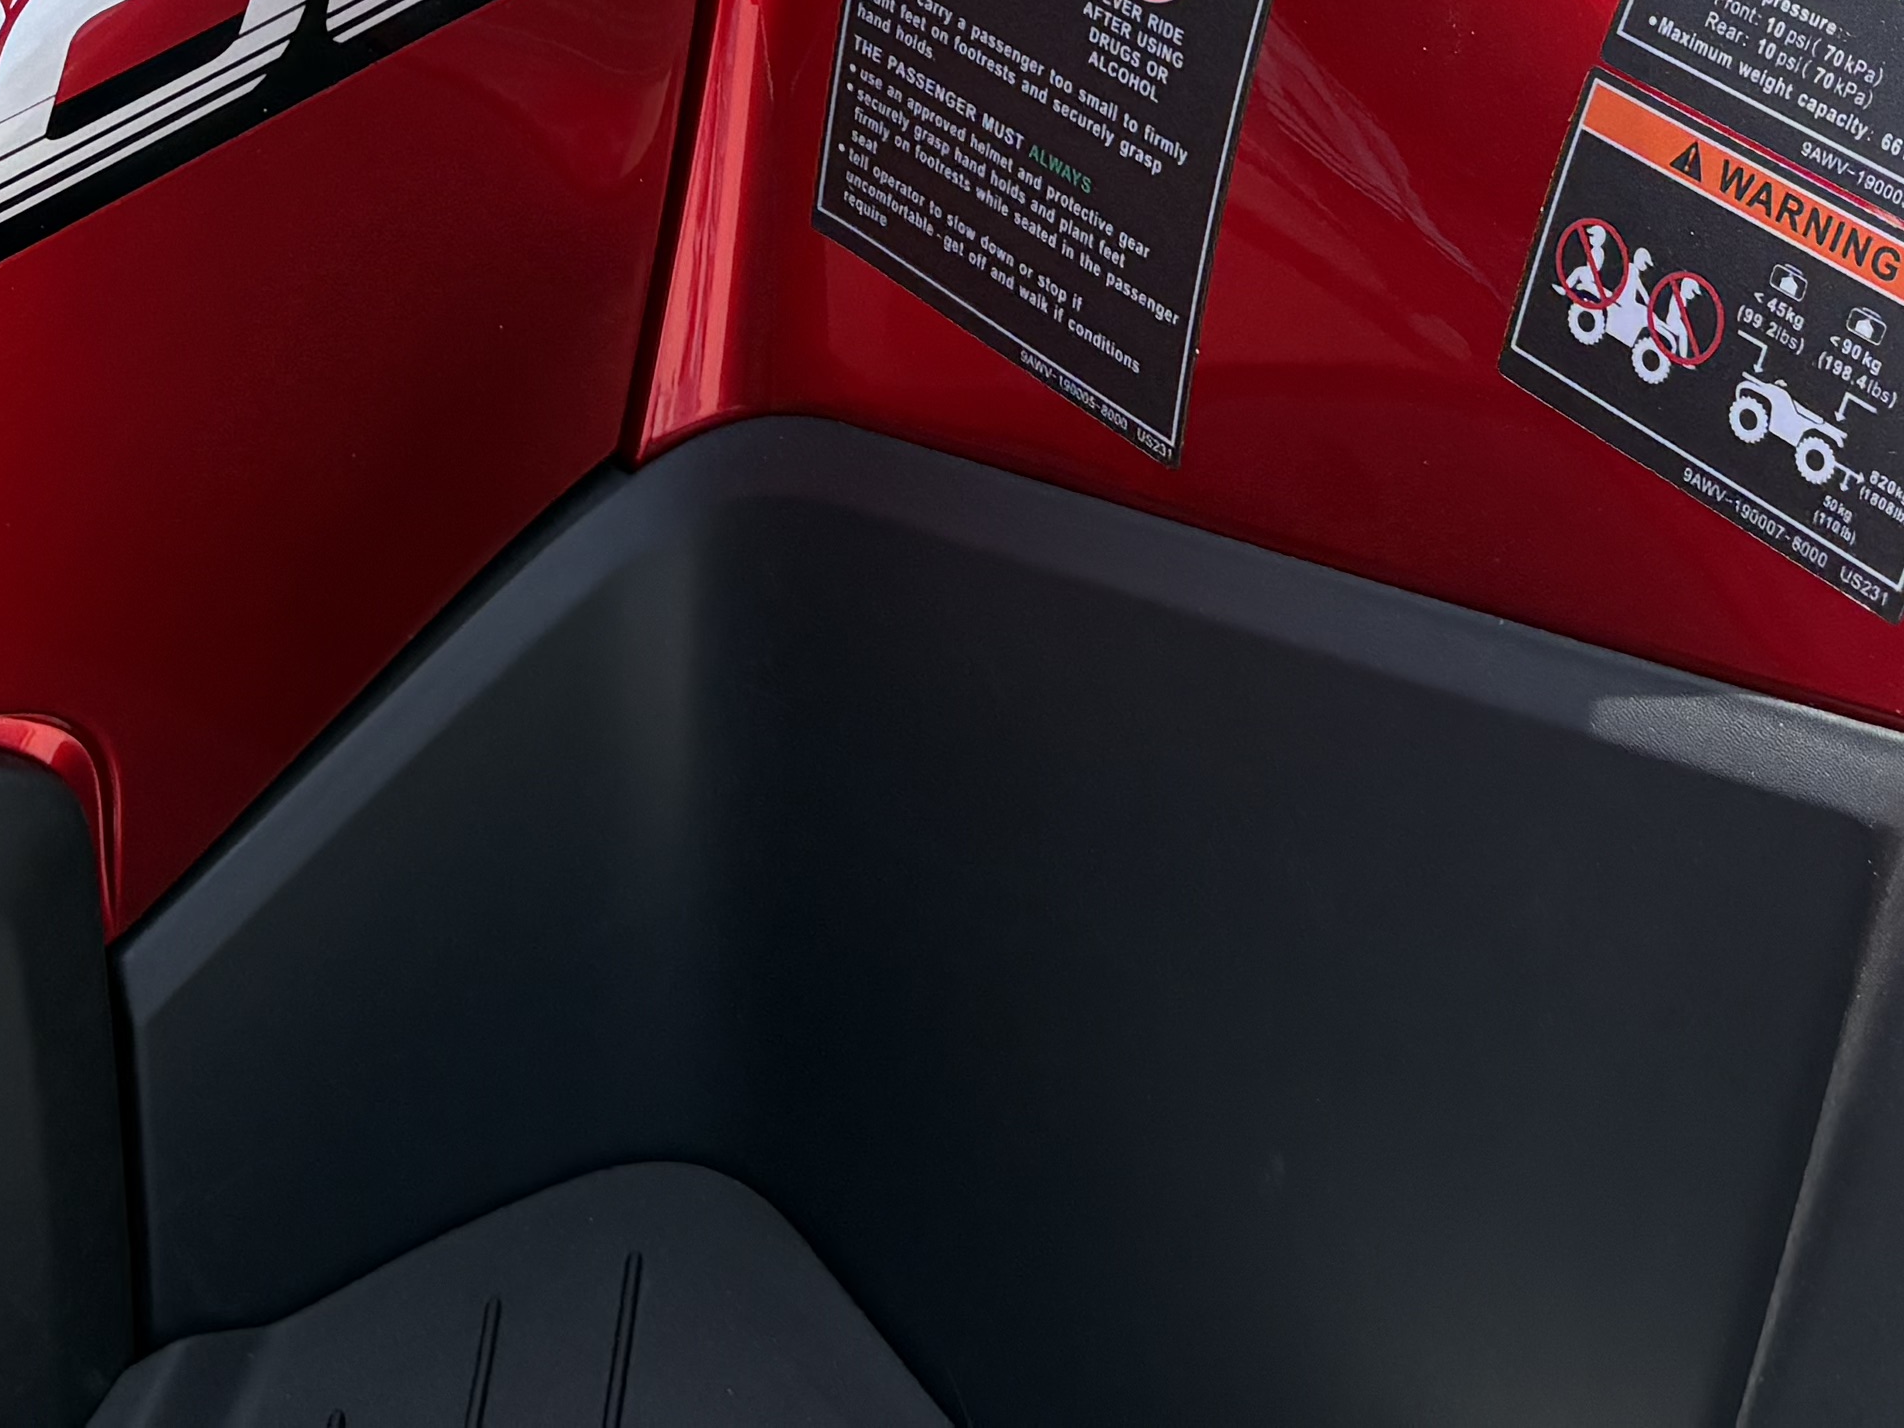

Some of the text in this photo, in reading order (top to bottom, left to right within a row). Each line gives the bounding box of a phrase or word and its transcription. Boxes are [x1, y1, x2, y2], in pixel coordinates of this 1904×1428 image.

[857, 2, 891, 33] hand
[1082, 1, 1184, 68] AFTER USING
[1088, 26, 1168, 84] DRUGS OR
[1147, 13, 1184, 46] RIDE
[1704, 11, 1749, 46] Rear:
[900, 4, 926, 31] feet
[930, 26, 949, 45] on
[953, 35, 1016, 85] footrests
[1021, 79, 1048, 104] and
[1052, 98, 1115, 147] securely
[1119, 139, 1162, 175] grasp
[957, 17, 966, 30] a
[970, 25, 1045, 76] passenger
[1049, 68, 1073, 93] too
[1078, 88, 1118, 121] small
[1123, 112, 1138, 133] to
[1144, 124, 1188, 166] firmly
[1087, 51, 1158, 103] ALCOHOL
[1657, 16, 1733, 69] Maximum
[1738, 61, 1793, 100] weight
[851, 129, 878, 154] seat
[854, 34, 1092, 194] THE PASSENGER MUST ALWAYS
[856, 89, 1125, 268] securely grasp hand holds and plant feet
[859, 68, 1150, 258] use an approved helmet and protective gear
[843, 190, 887, 227] require
[848, 147, 1083, 312] tell operator to slow down or stop if
[854, 106, 1179, 325] firmly on footrests while seated in the passenger
[1719, 159, 1901, 281] WARNING
[845, 170, 934, 236] uncomfortable
[943, 235, 964, 256] get
[968, 251, 987, 270] off
[990, 266, 1014, 290] and
[1019, 285, 1048, 313] walk
[1053, 304, 1064, 322] if
[1067, 318, 1140, 373] conditions
[1136, 427, 1172, 458] US231
[1839, 565, 1888, 606] US231
